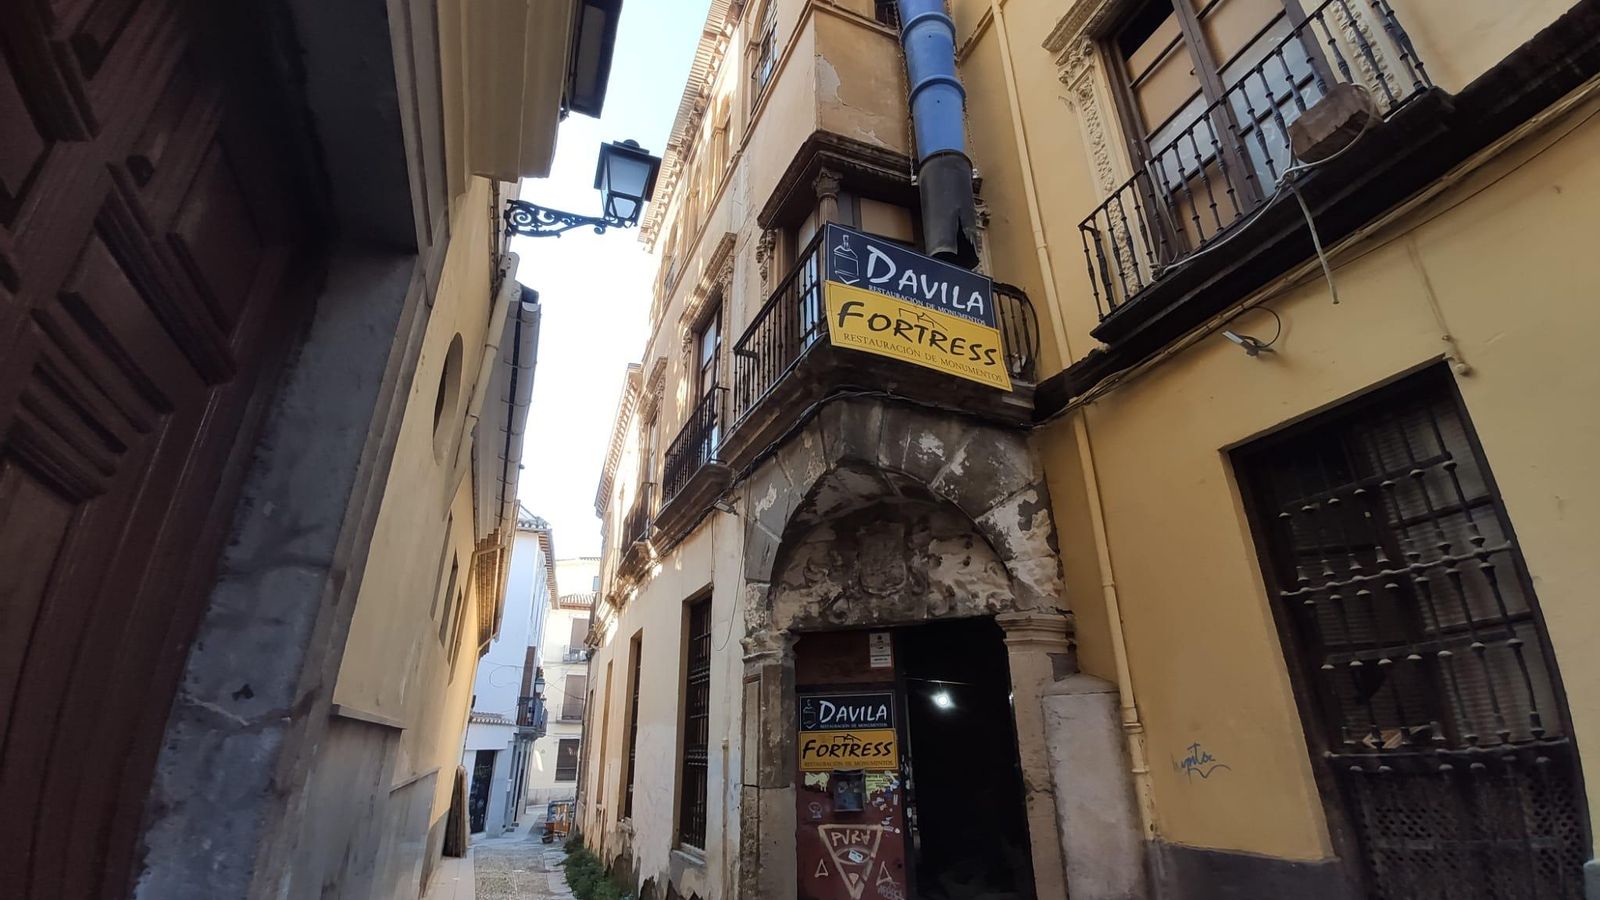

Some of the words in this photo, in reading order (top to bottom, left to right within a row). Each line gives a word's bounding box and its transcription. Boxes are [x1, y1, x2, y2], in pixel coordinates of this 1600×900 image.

[867, 245, 984, 315] DAVILA
[926, 302, 935, 311] DE
[838, 301, 997, 366] FORTRESS
[925, 353, 937, 363] DE
[940, 358, 1003, 383] MONUMENTOS
[819, 700, 887, 723] DAVILA
[802, 740, 893, 759] FORTRESS
